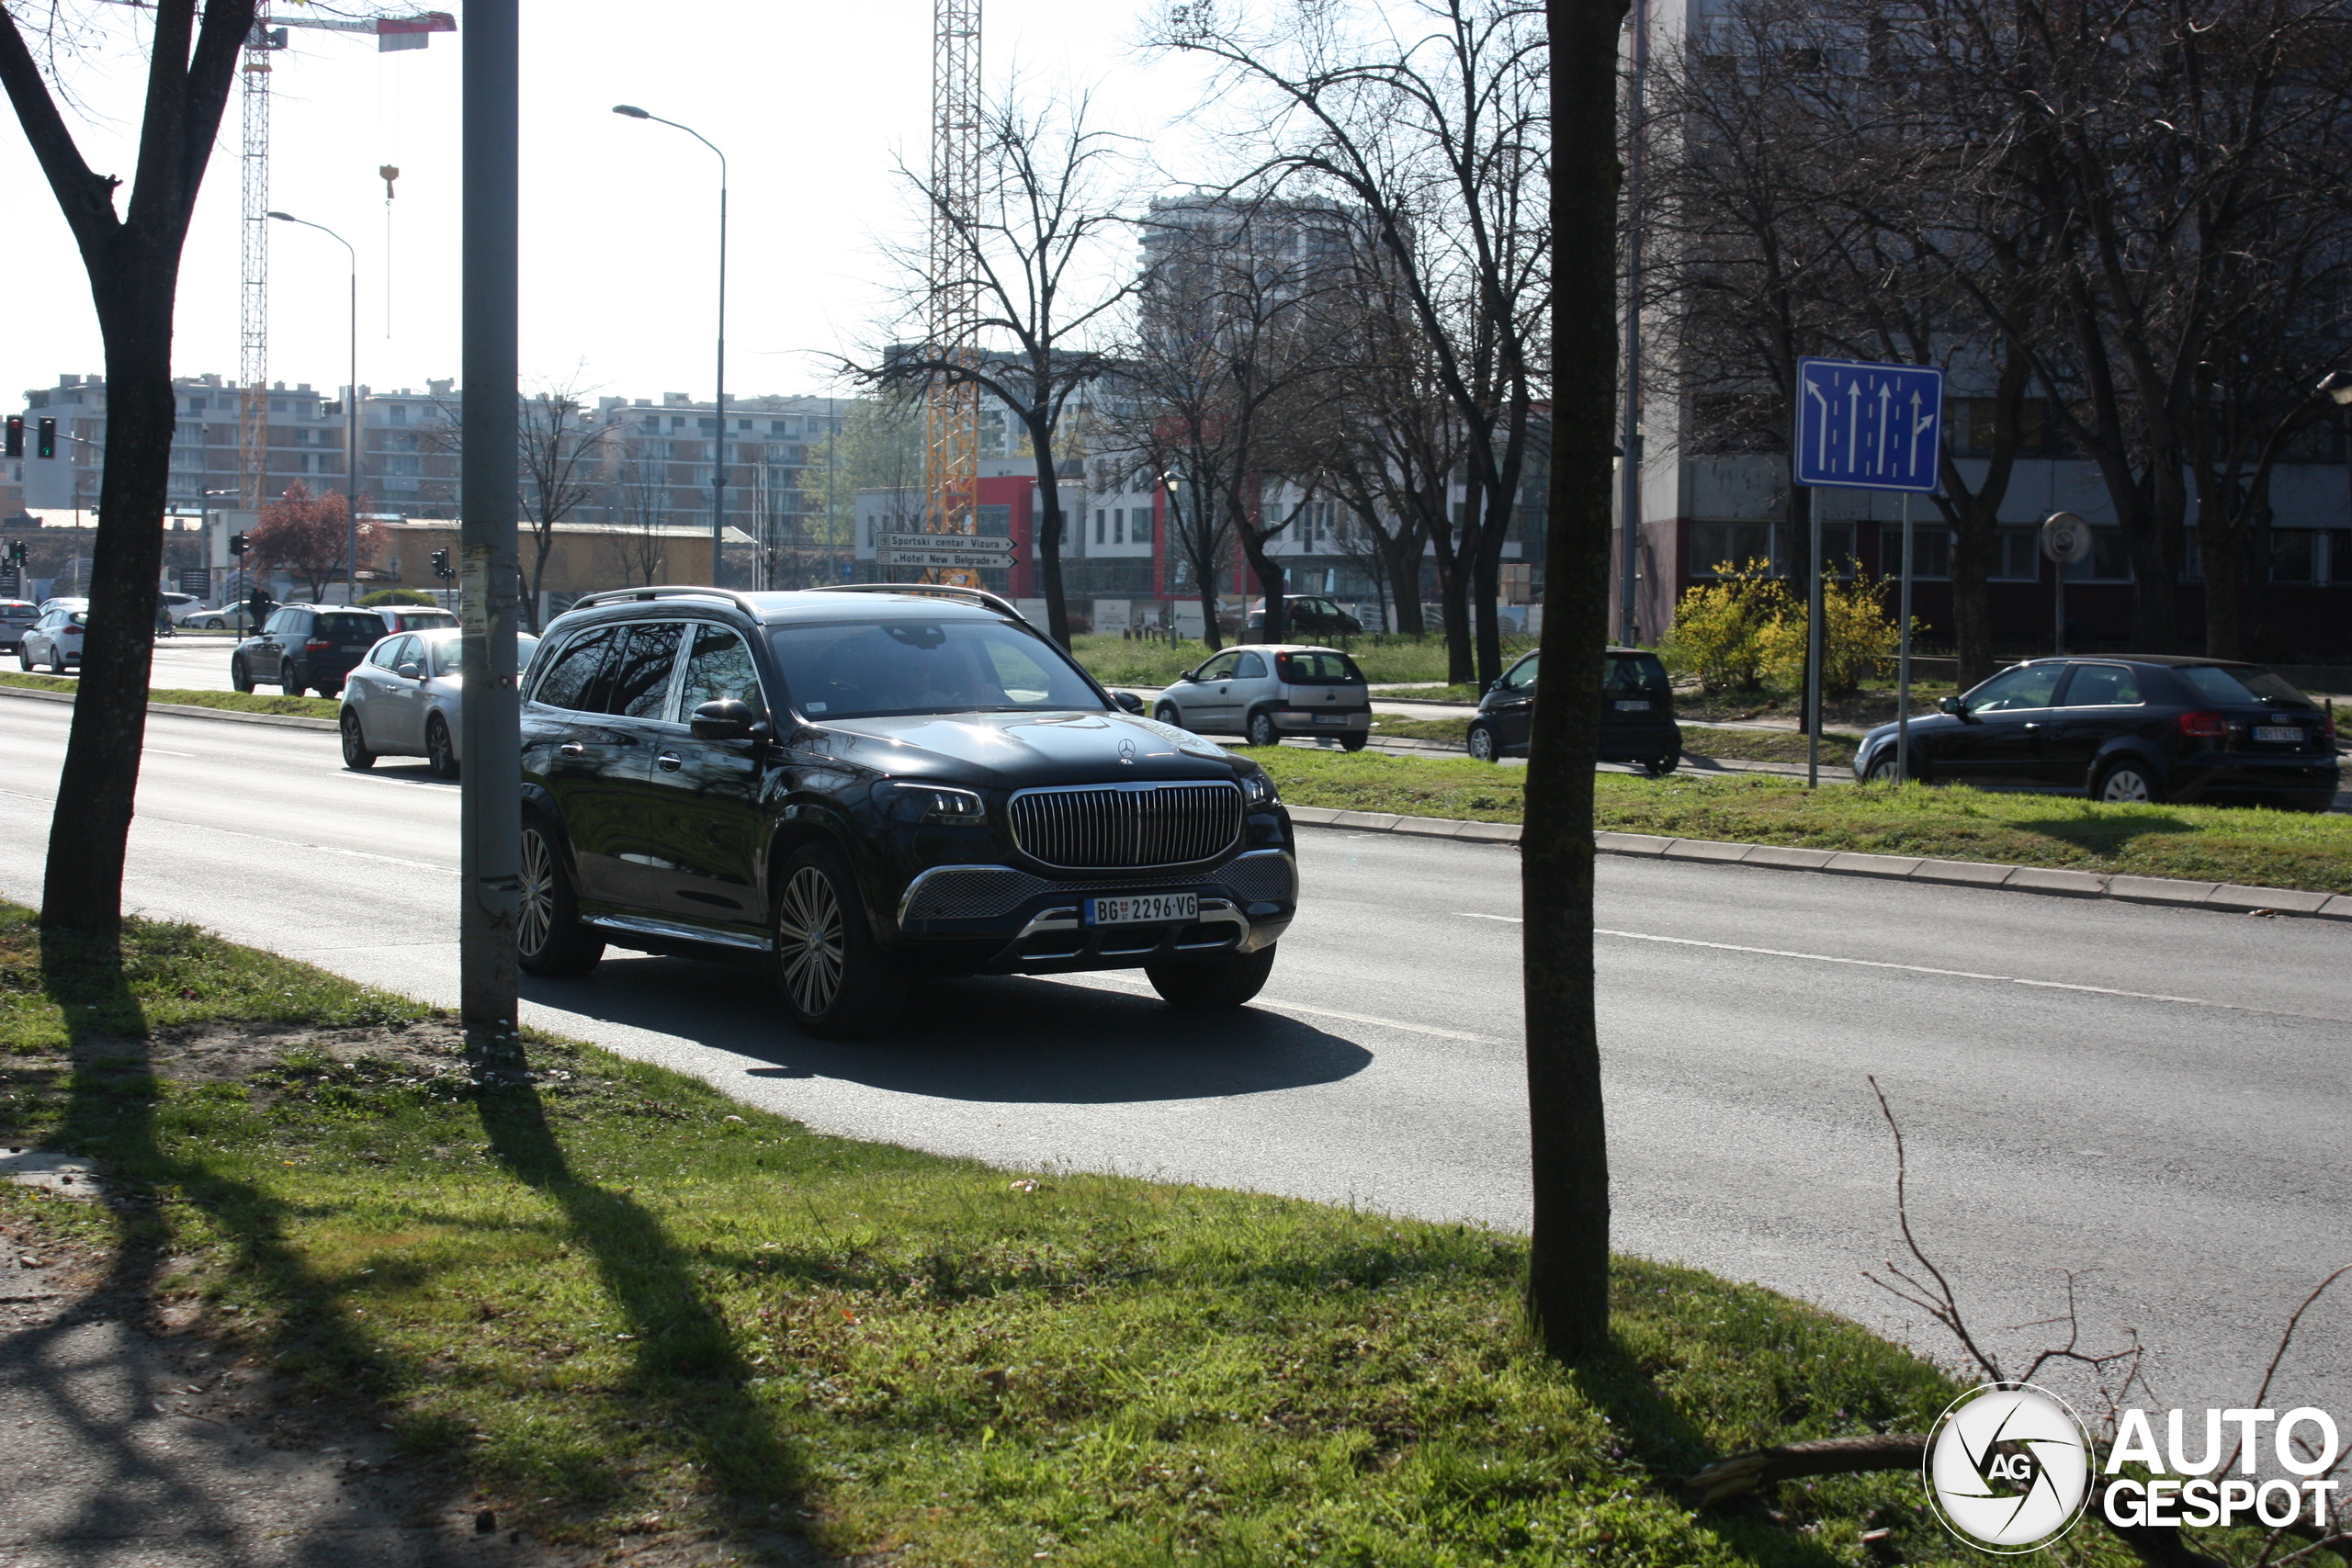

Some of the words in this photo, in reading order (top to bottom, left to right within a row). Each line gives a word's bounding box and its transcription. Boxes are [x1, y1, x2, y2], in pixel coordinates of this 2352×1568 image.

[891, 536, 931, 547] Sportski
[935, 537, 965, 547] centar
[971, 538, 1000, 548] Vizura
[899, 553, 924, 563] Hotel
[929, 555, 948, 564] New
[955, 555, 990, 566] Belgrade
[1097, 900, 1118, 921] BG
